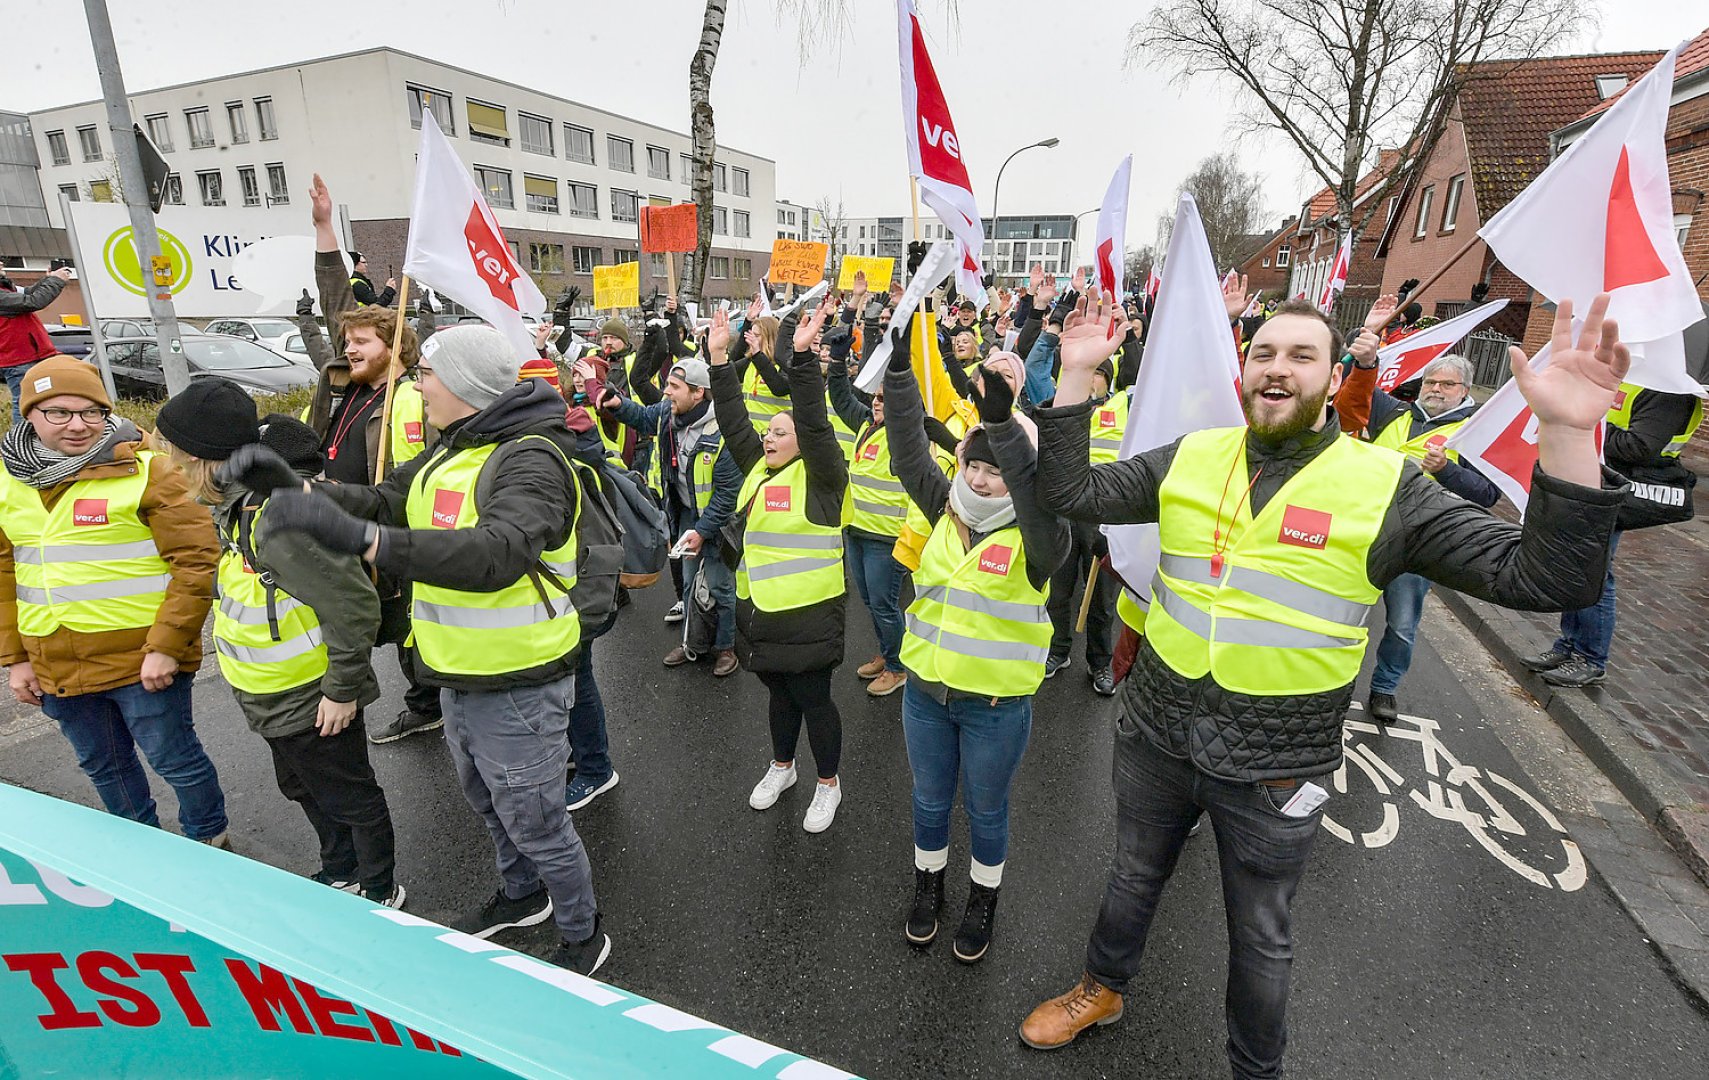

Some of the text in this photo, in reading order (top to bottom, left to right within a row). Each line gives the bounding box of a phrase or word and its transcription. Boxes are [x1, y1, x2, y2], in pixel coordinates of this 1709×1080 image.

[921, 115, 961, 160] ve
[1630, 481, 1685, 507] UMA
[766, 500, 789, 509] ver.di
[74, 513, 106, 523] ver.di
[433, 510, 457, 525] ver.di
[1283, 526, 1326, 546] ver.di
[980, 557, 1008, 574] ver.di
[2, 950, 212, 1030] IST
